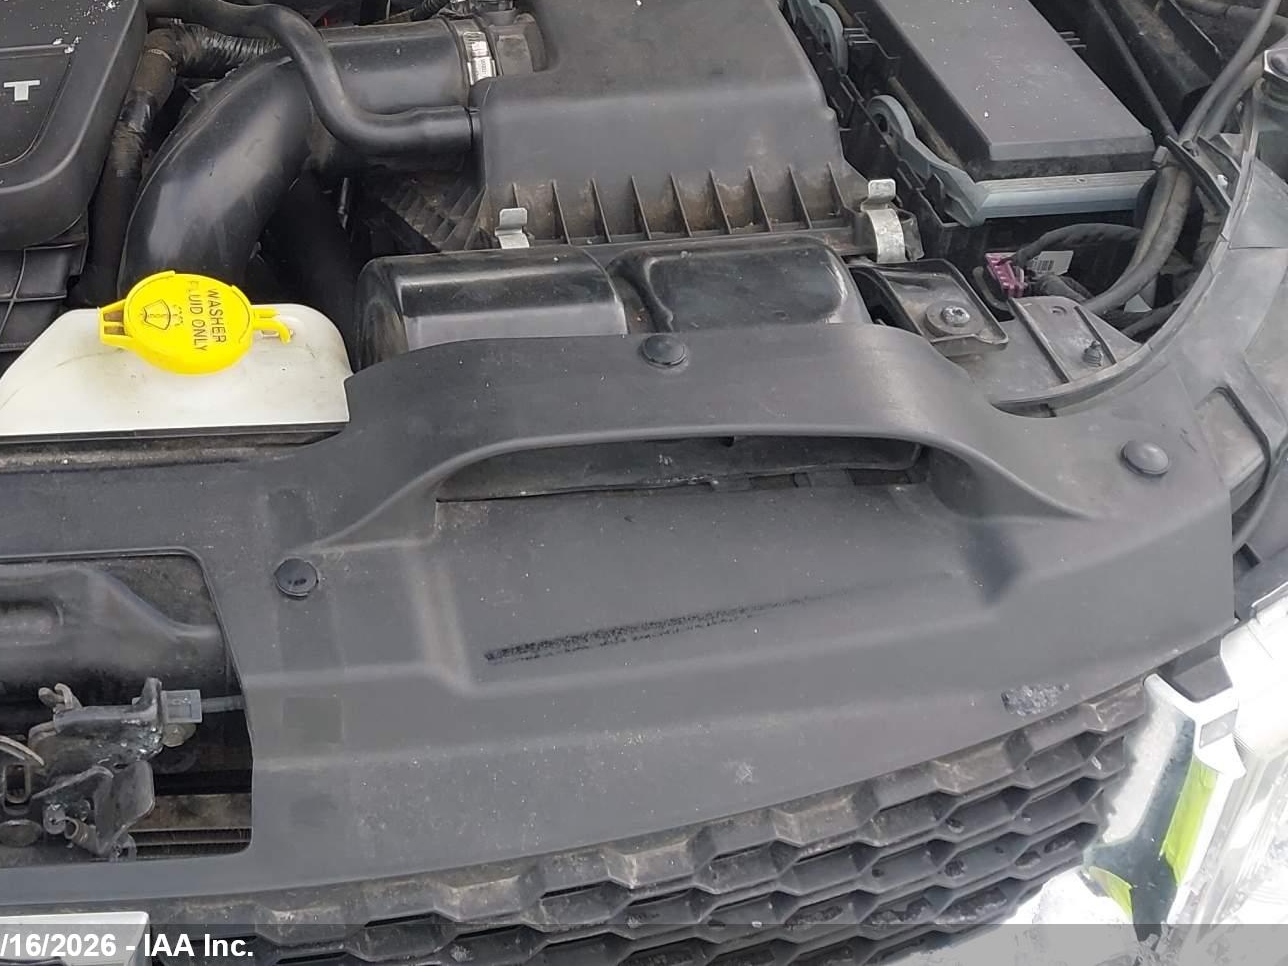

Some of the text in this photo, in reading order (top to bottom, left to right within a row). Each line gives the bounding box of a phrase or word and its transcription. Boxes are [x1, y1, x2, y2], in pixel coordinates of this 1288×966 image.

[187, 280, 208, 352] FLUID ONLY
[207, 288, 227, 344] WASHER
